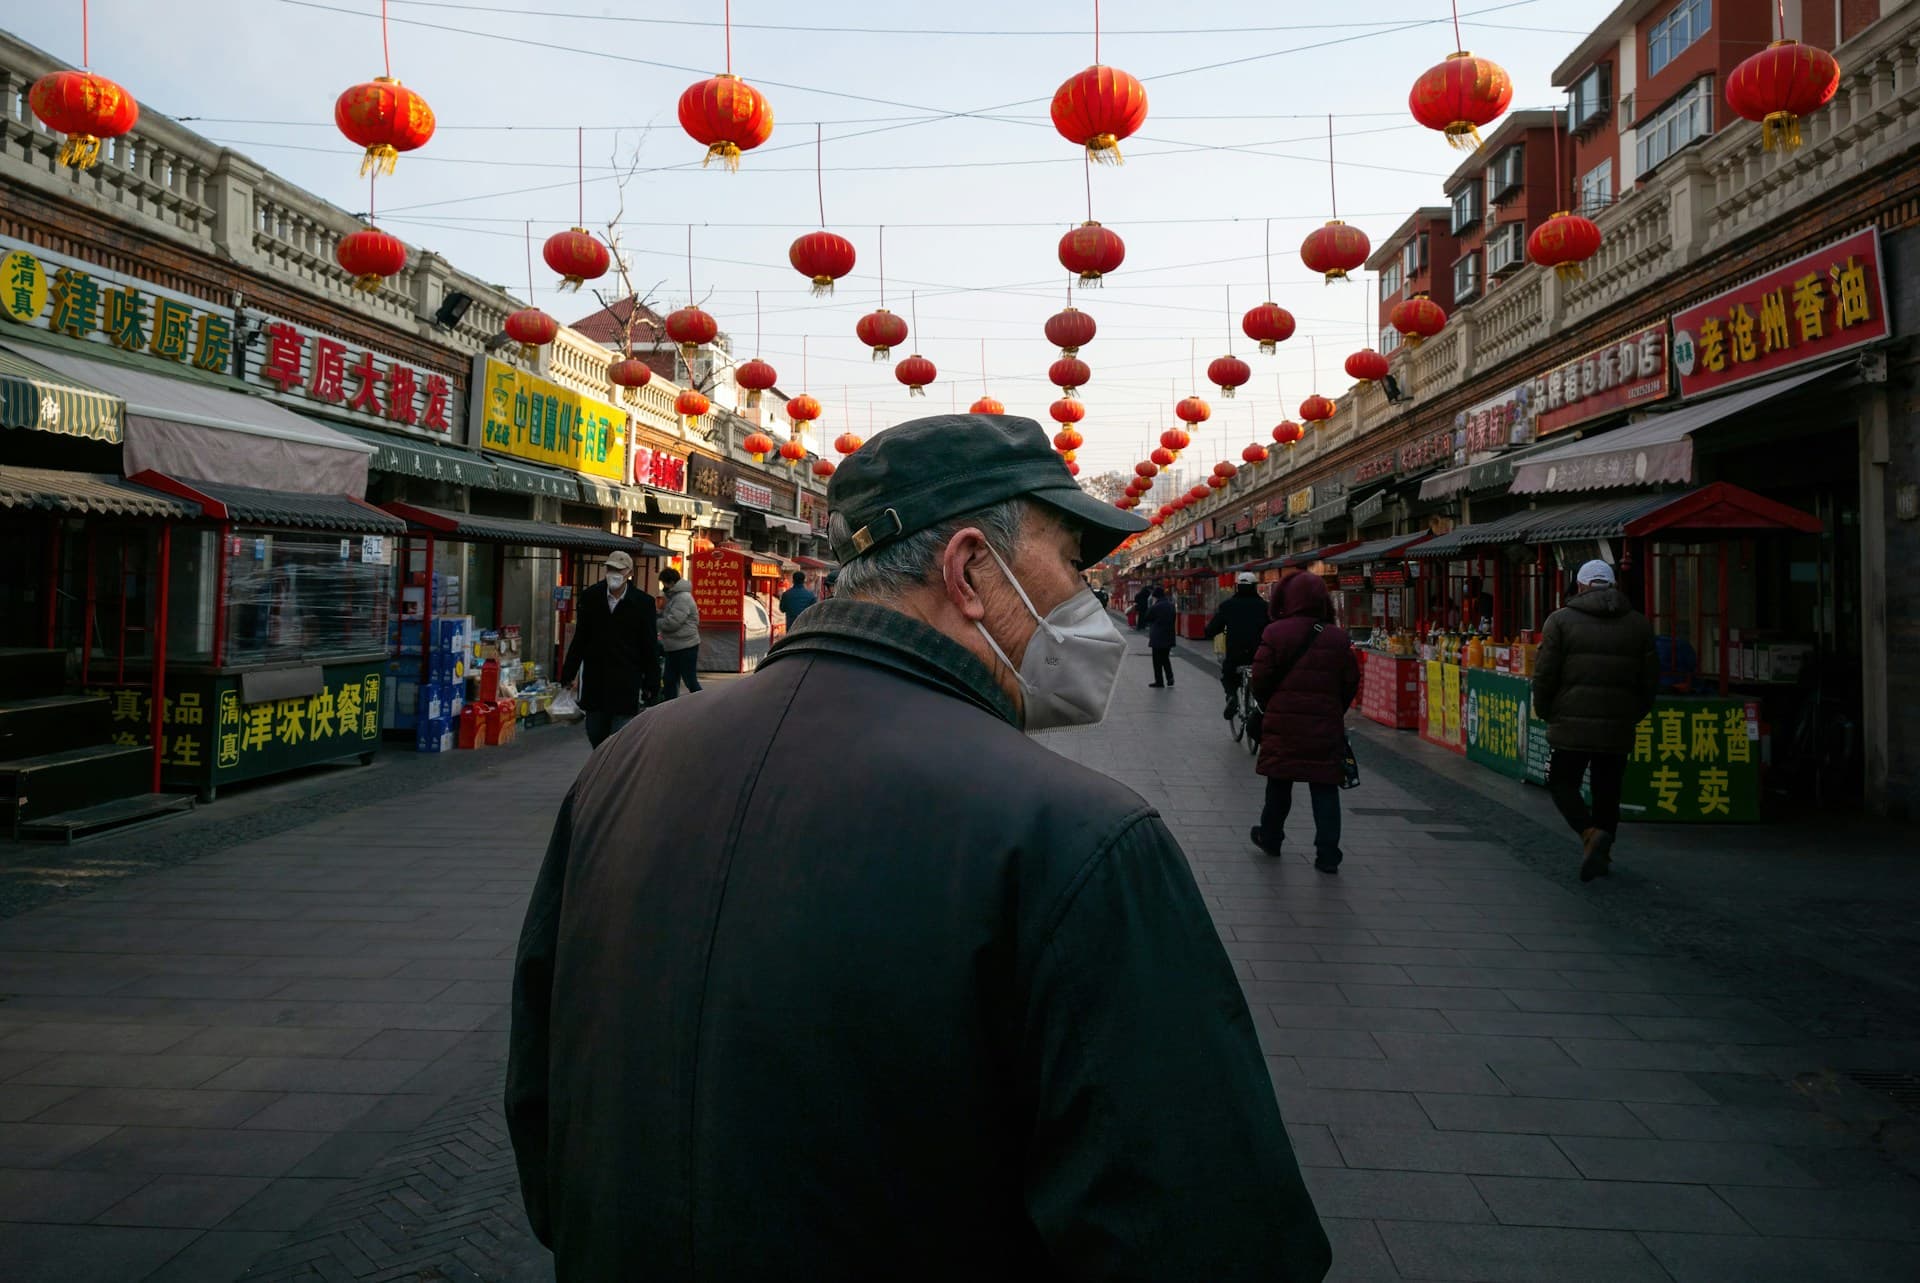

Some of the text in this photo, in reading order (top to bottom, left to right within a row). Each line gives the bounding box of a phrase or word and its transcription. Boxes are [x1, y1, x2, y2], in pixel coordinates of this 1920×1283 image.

[11, 254, 36, 317] 清真
[1699, 256, 1870, 373] 老沧州香油
[50, 266, 230, 374] 津味厨房
[1676, 342, 1692, 363] 清真
[260, 322, 448, 432] 草原大批发
[1534, 330, 1661, 414] 品牌箱包折扣店
[84, 688, 203, 726] 真食品
[221, 696, 240, 763] 清真
[241, 683, 362, 751] 津味快餐
[363, 679, 379, 734] 清真
[1627, 707, 1751, 764] 清真麻酱
[1649, 765, 1731, 815] 专卖
